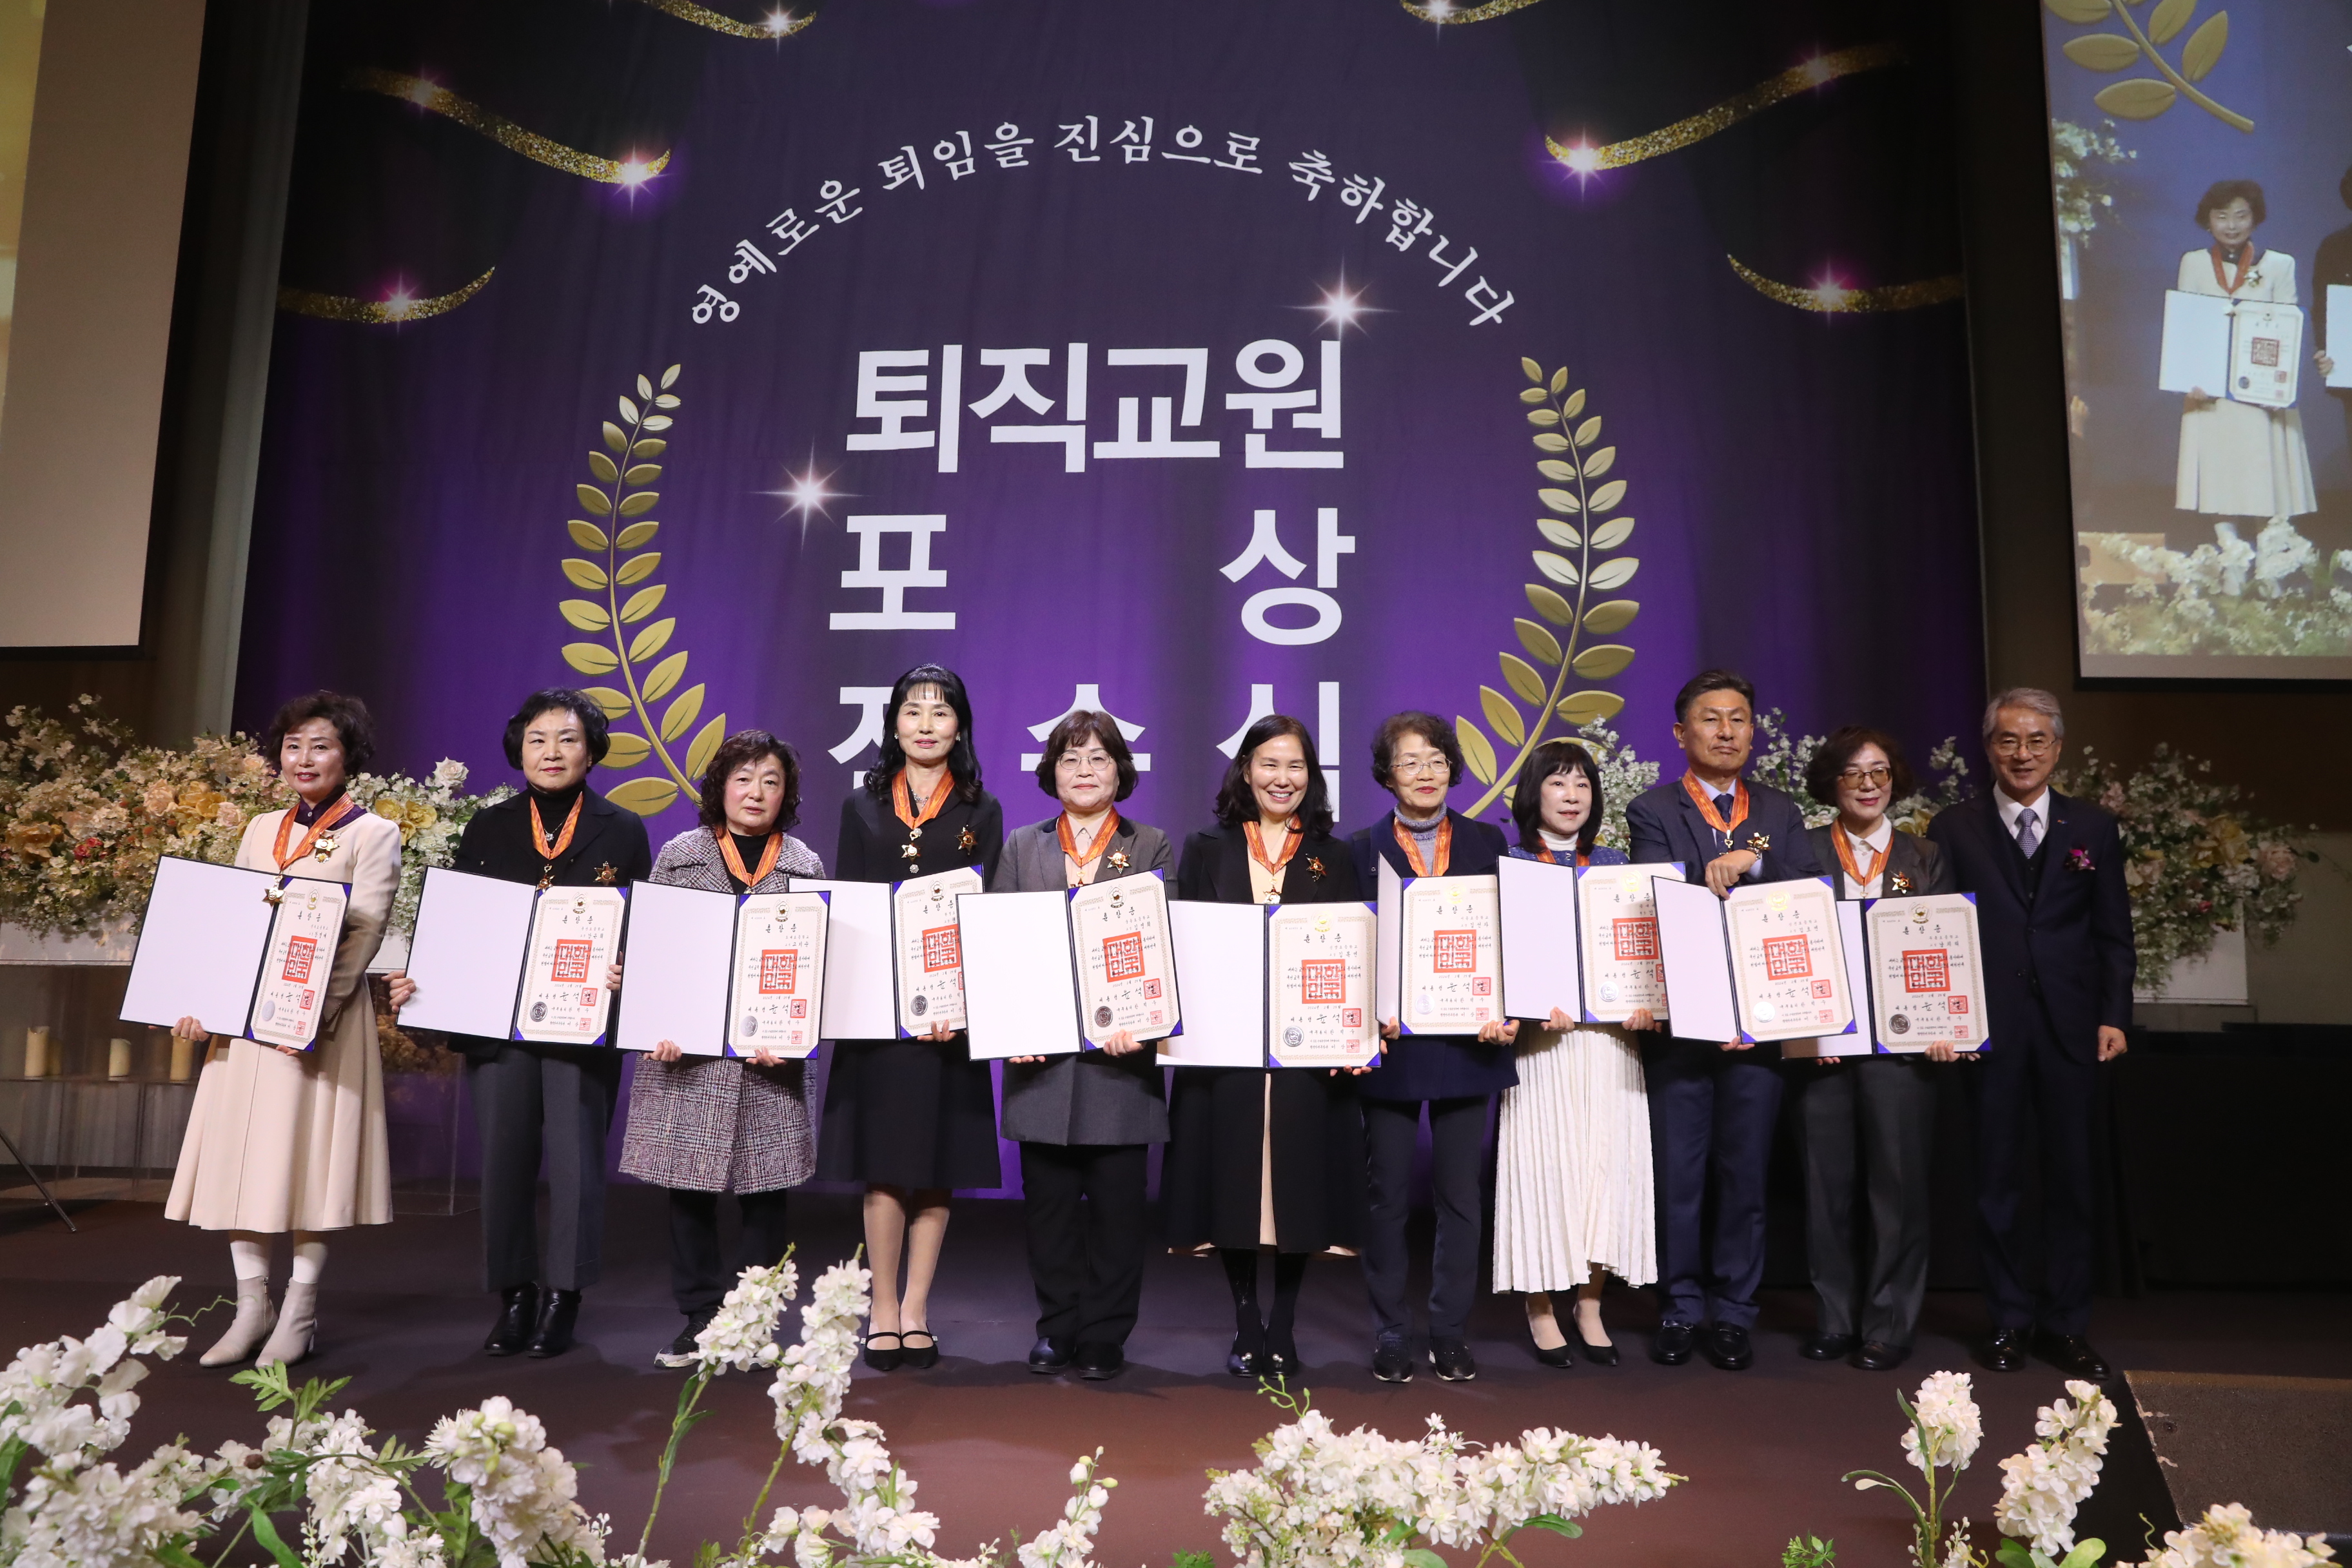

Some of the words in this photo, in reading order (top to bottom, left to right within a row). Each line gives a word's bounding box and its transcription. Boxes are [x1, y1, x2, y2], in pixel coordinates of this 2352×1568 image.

[691, 179, 863, 325] 영예로운
[879, 121, 1035, 191] 퇴임을
[1054, 114, 1264, 175] 진심으로
[1288, 149, 1515, 327] 축하합니다
[846, 338, 1344, 473] 퇴직교원
